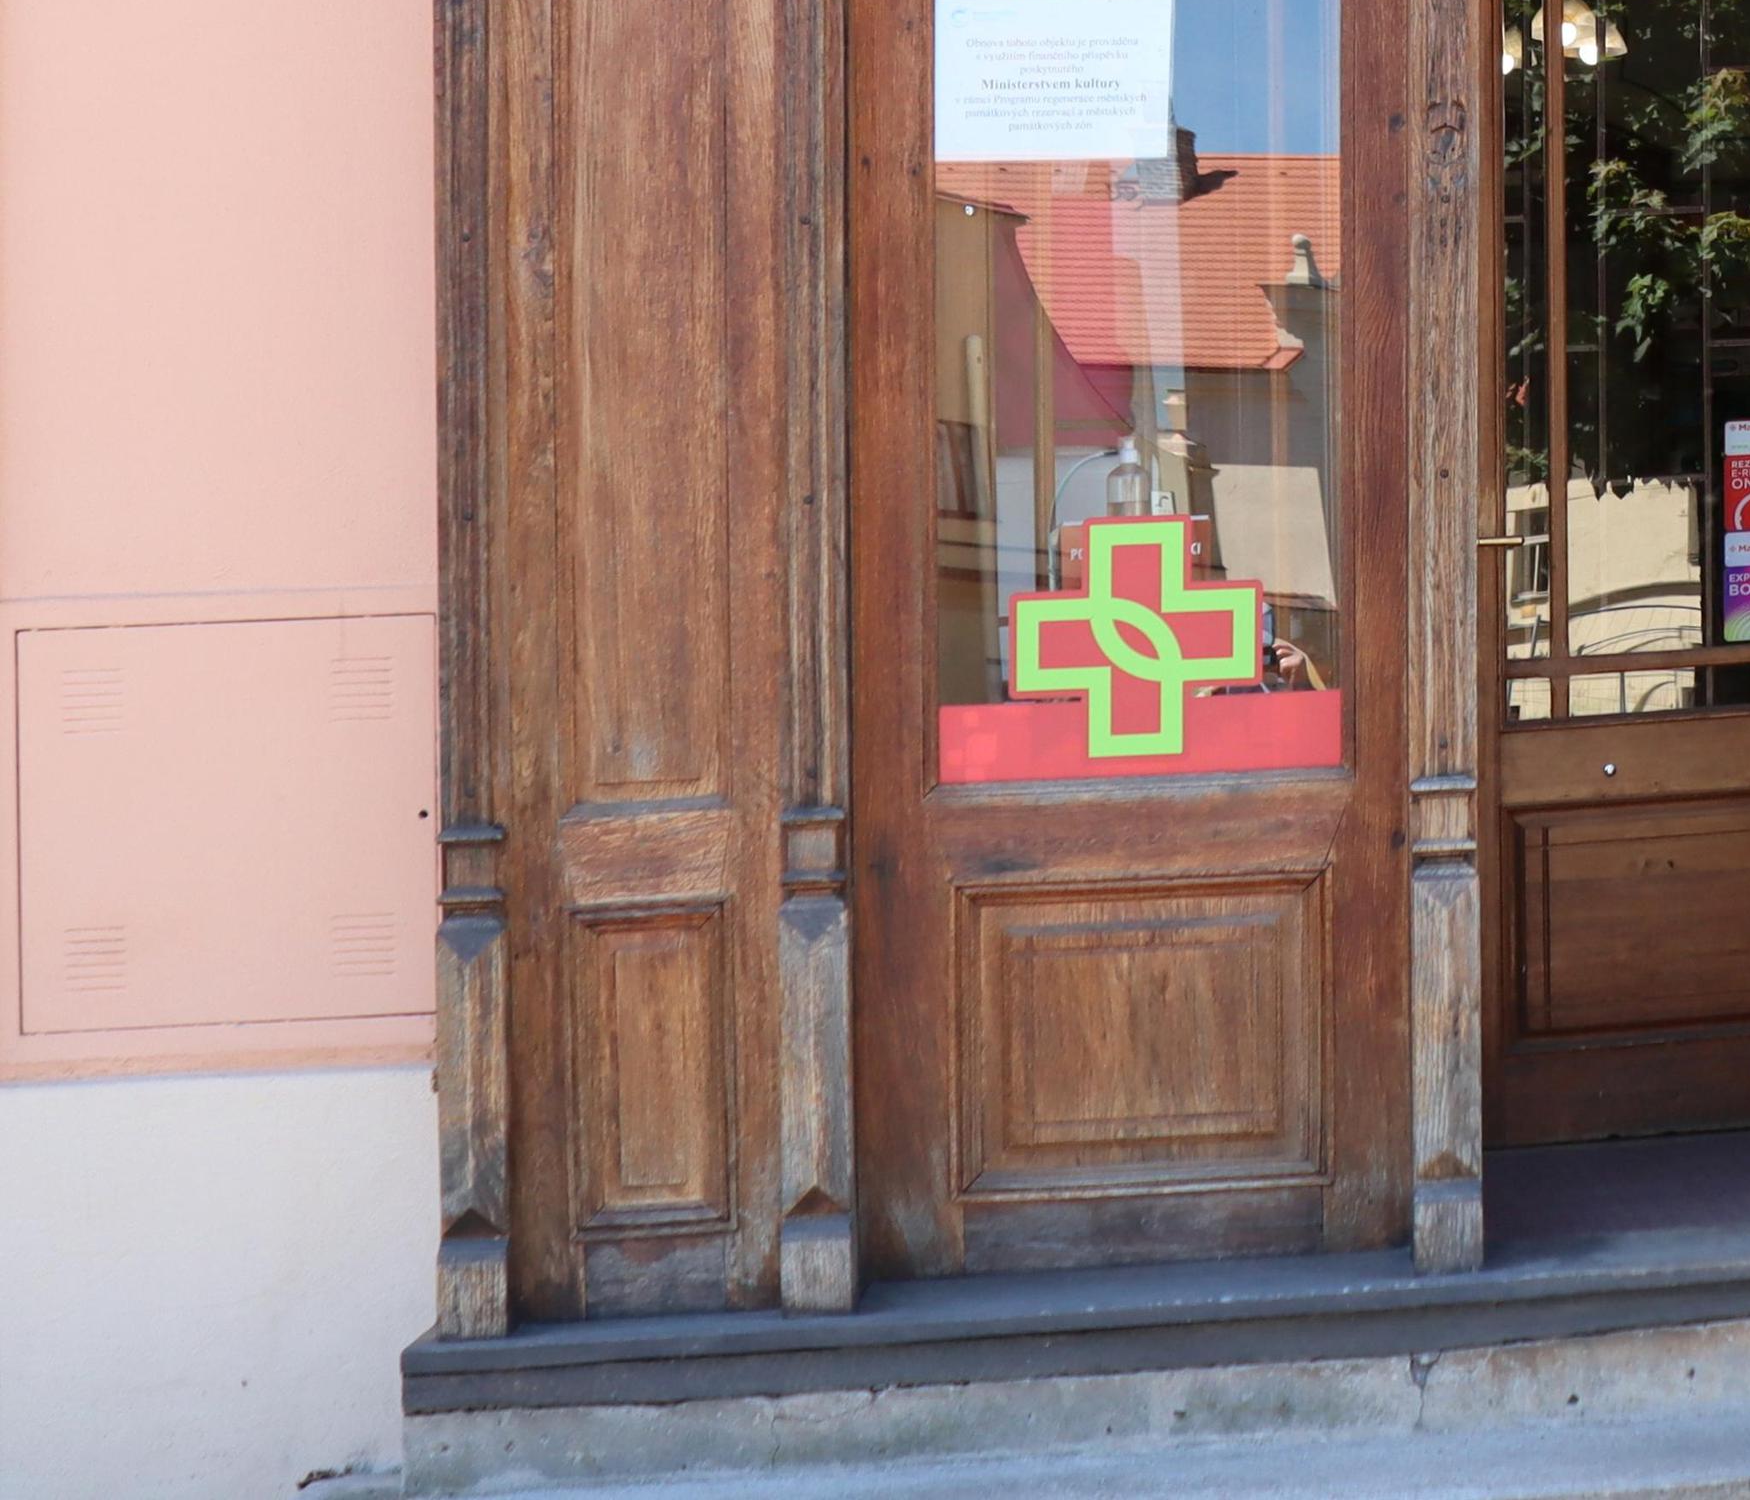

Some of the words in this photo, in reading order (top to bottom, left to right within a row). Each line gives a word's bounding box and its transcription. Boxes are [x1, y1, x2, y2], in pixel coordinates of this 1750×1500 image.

[966, 37, 1004, 48] Obnova
[1040, 36, 1075, 48] objektu
[1077, 38, 1087, 49] je
[981, 78, 1071, 90] Ministerstvem
[1074, 77, 1121, 91] kultury
